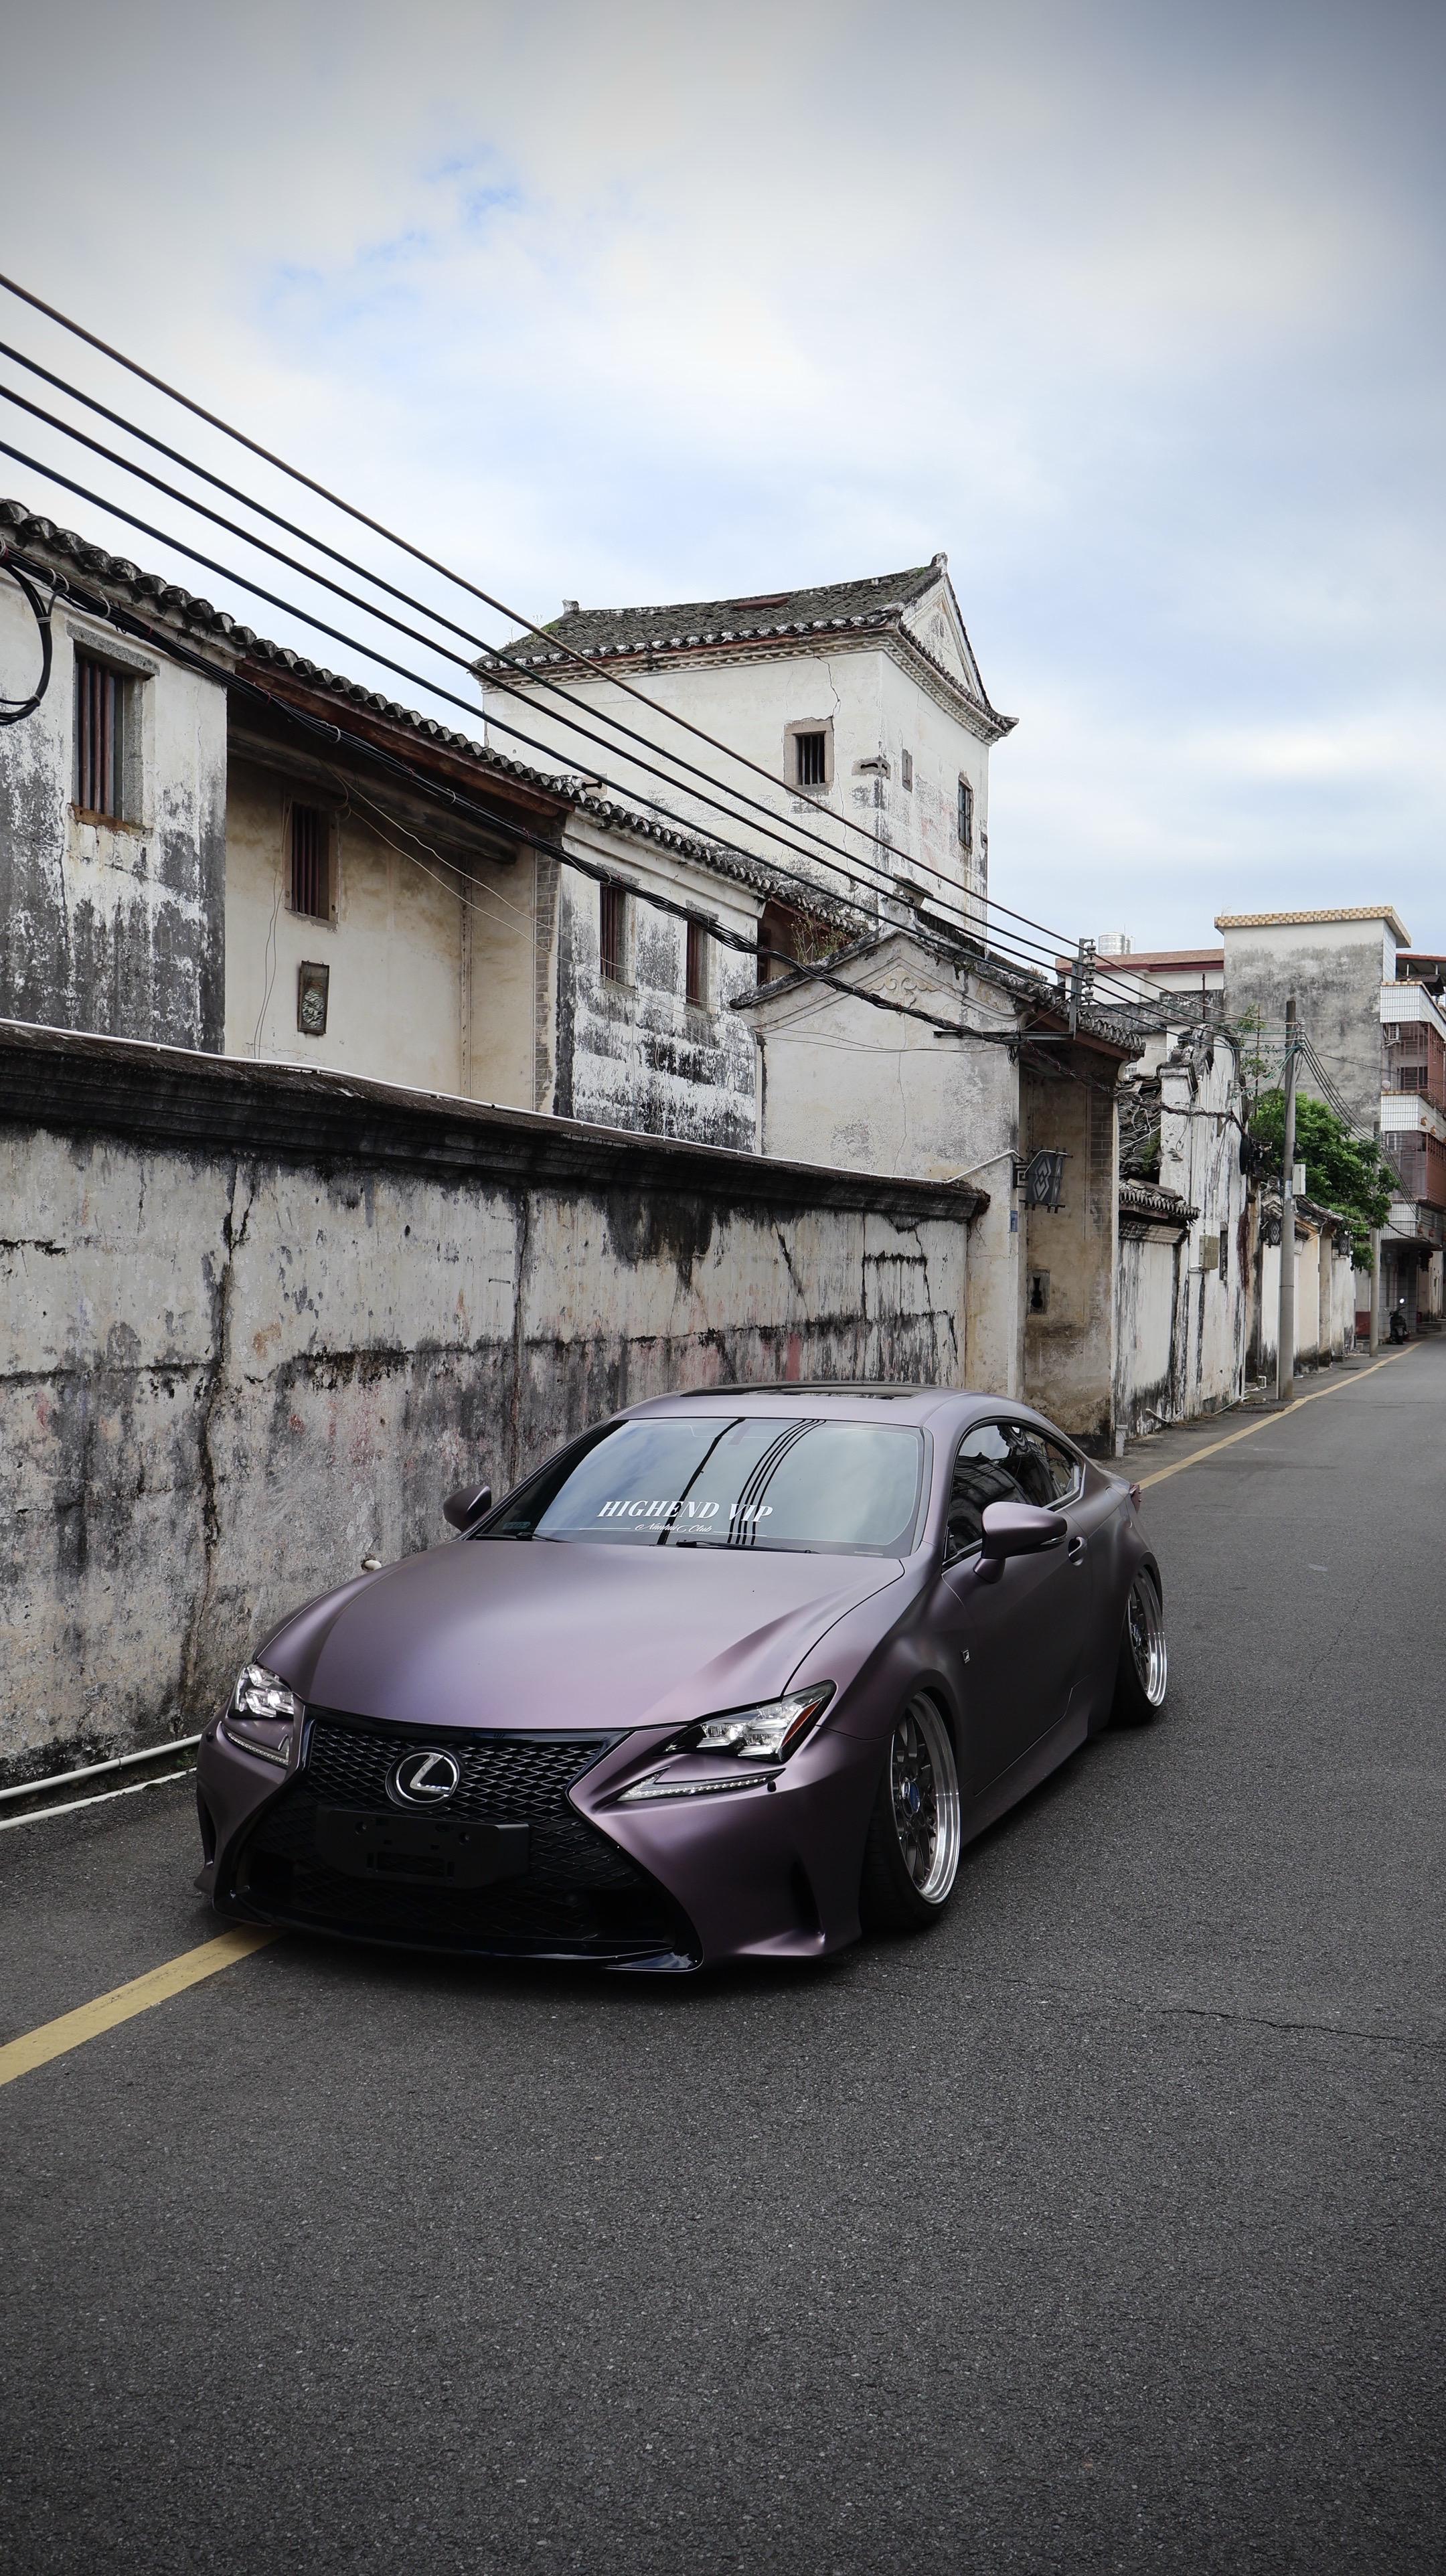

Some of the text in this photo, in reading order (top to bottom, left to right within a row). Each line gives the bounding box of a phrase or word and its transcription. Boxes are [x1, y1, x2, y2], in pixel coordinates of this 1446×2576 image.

[596, 1500, 773, 1523] HIGHEND VIP
[678, 1524, 712, 1533] Club
